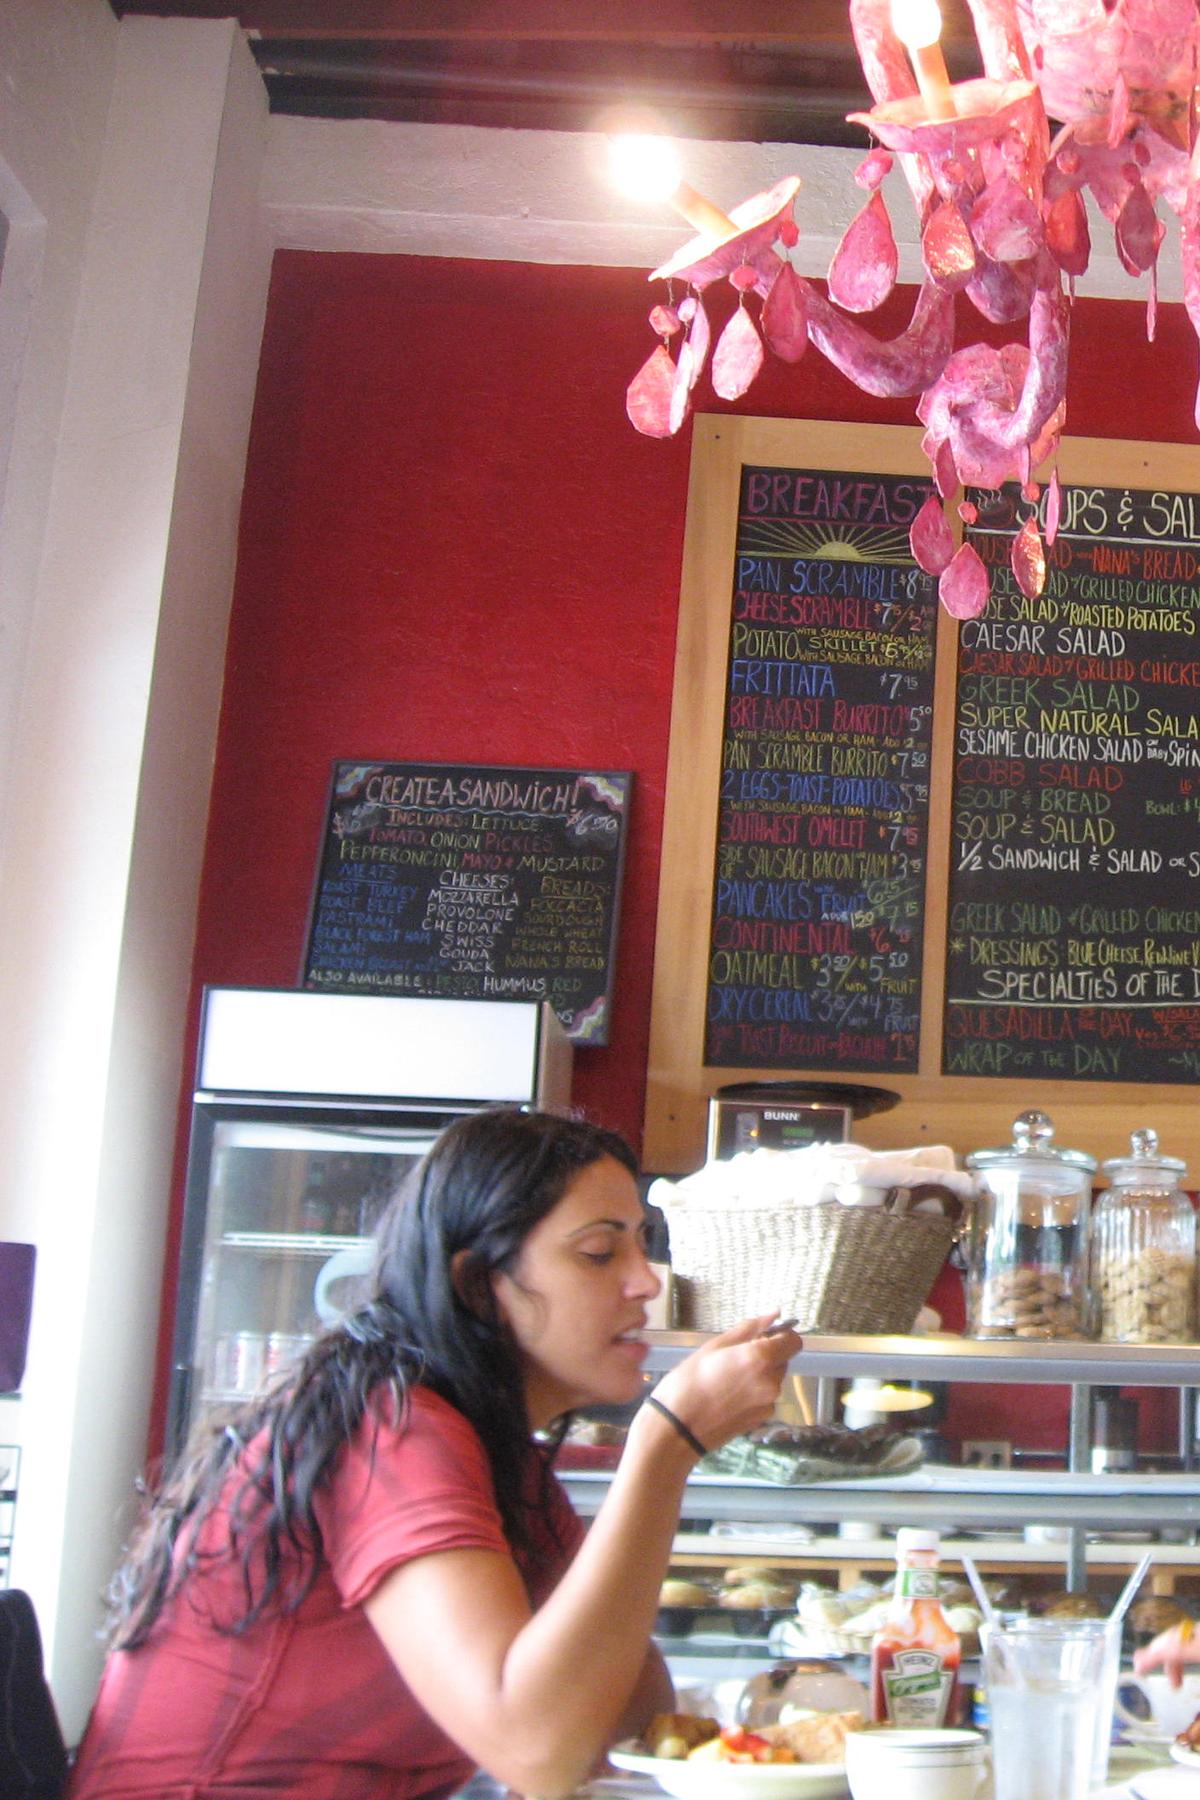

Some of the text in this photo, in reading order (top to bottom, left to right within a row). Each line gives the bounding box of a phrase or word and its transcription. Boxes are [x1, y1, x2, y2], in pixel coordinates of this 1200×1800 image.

[1117, 490, 1134, 532] &
[738, 558, 900, 601] PAN SCRAMBLE
[1143, 550, 1197, 581] BREAD
[1080, 575, 1134, 605] GRILLED
[1010, 596, 1196, 636] SALAD POTATOES
[733, 622, 800, 659] POTATO
[808, 636, 877, 653] SKILLET
[961, 619, 1045, 656] CAESAR
[1056, 626, 1127, 658] SALAD
[731, 660, 836, 698] FRITTATA
[958, 650, 1013, 675] CAESAR
[1018, 653, 1064, 677] SALAD
[1076, 657, 1135, 682] GRILLED
[959, 673, 1140, 712] GREEK SALAD
[729, 697, 903, 736] BREAKFAST BURRITO
[957, 703, 1031, 730] SUPER
[1040, 708, 1141, 737] NATURAL
[724, 741, 888, 778] PAN SCRAMBLE BURRITO
[958, 728, 1022, 759] SESAME
[1024, 730, 1090, 762] CHICKEN
[1093, 736, 1144, 764] SALAD
[956, 757, 1124, 793] COBB SALAD
[956, 785, 1017, 810] SOUP
[1040, 789, 1111, 816] BREAD
[430, 831, 480, 853] ONION
[720, 810, 801, 844] SOUTHWEST
[808, 817, 866, 849] OMELET
[955, 811, 1017, 841] SOUP
[1040, 814, 1116, 846] SALAD
[516, 855, 606, 873] MUSTARD
[988, 843, 1080, 872] SANDWICH
[1107, 849, 1163, 875] SALAD
[1169, 856, 1187, 868] OR
[426, 903, 516, 921] PROVOLONE
[427, 889, 520, 907] MOZZARELLA
[716, 879, 811, 920] PANCAKES
[421, 918, 504, 935] CHEDDAR
[951, 903, 1005, 932] GREEK
[1011, 903, 1062, 934] SALAD
[440, 933, 495, 949] SWISS
[712, 915, 857, 956] CONTINENTAL
[1068, 938, 1097, 966] BLUE
[439, 948, 490, 961] GOUDA
[451, 959, 496, 974] JACK
[308, 968, 343, 983] ALSO
[483, 975, 546, 993] HUMMUS
[711, 951, 916, 995] OATMEAL FRUIT
[976, 966, 1184, 1001] SPECIALTIES OF THE
[951, 1005, 1075, 1041] QUESADILLA
[1074, 1044, 1124, 1075] DAY
[763, 1110, 800, 1122] BUNN
[902, 1654, 936, 1667] HEINZ
